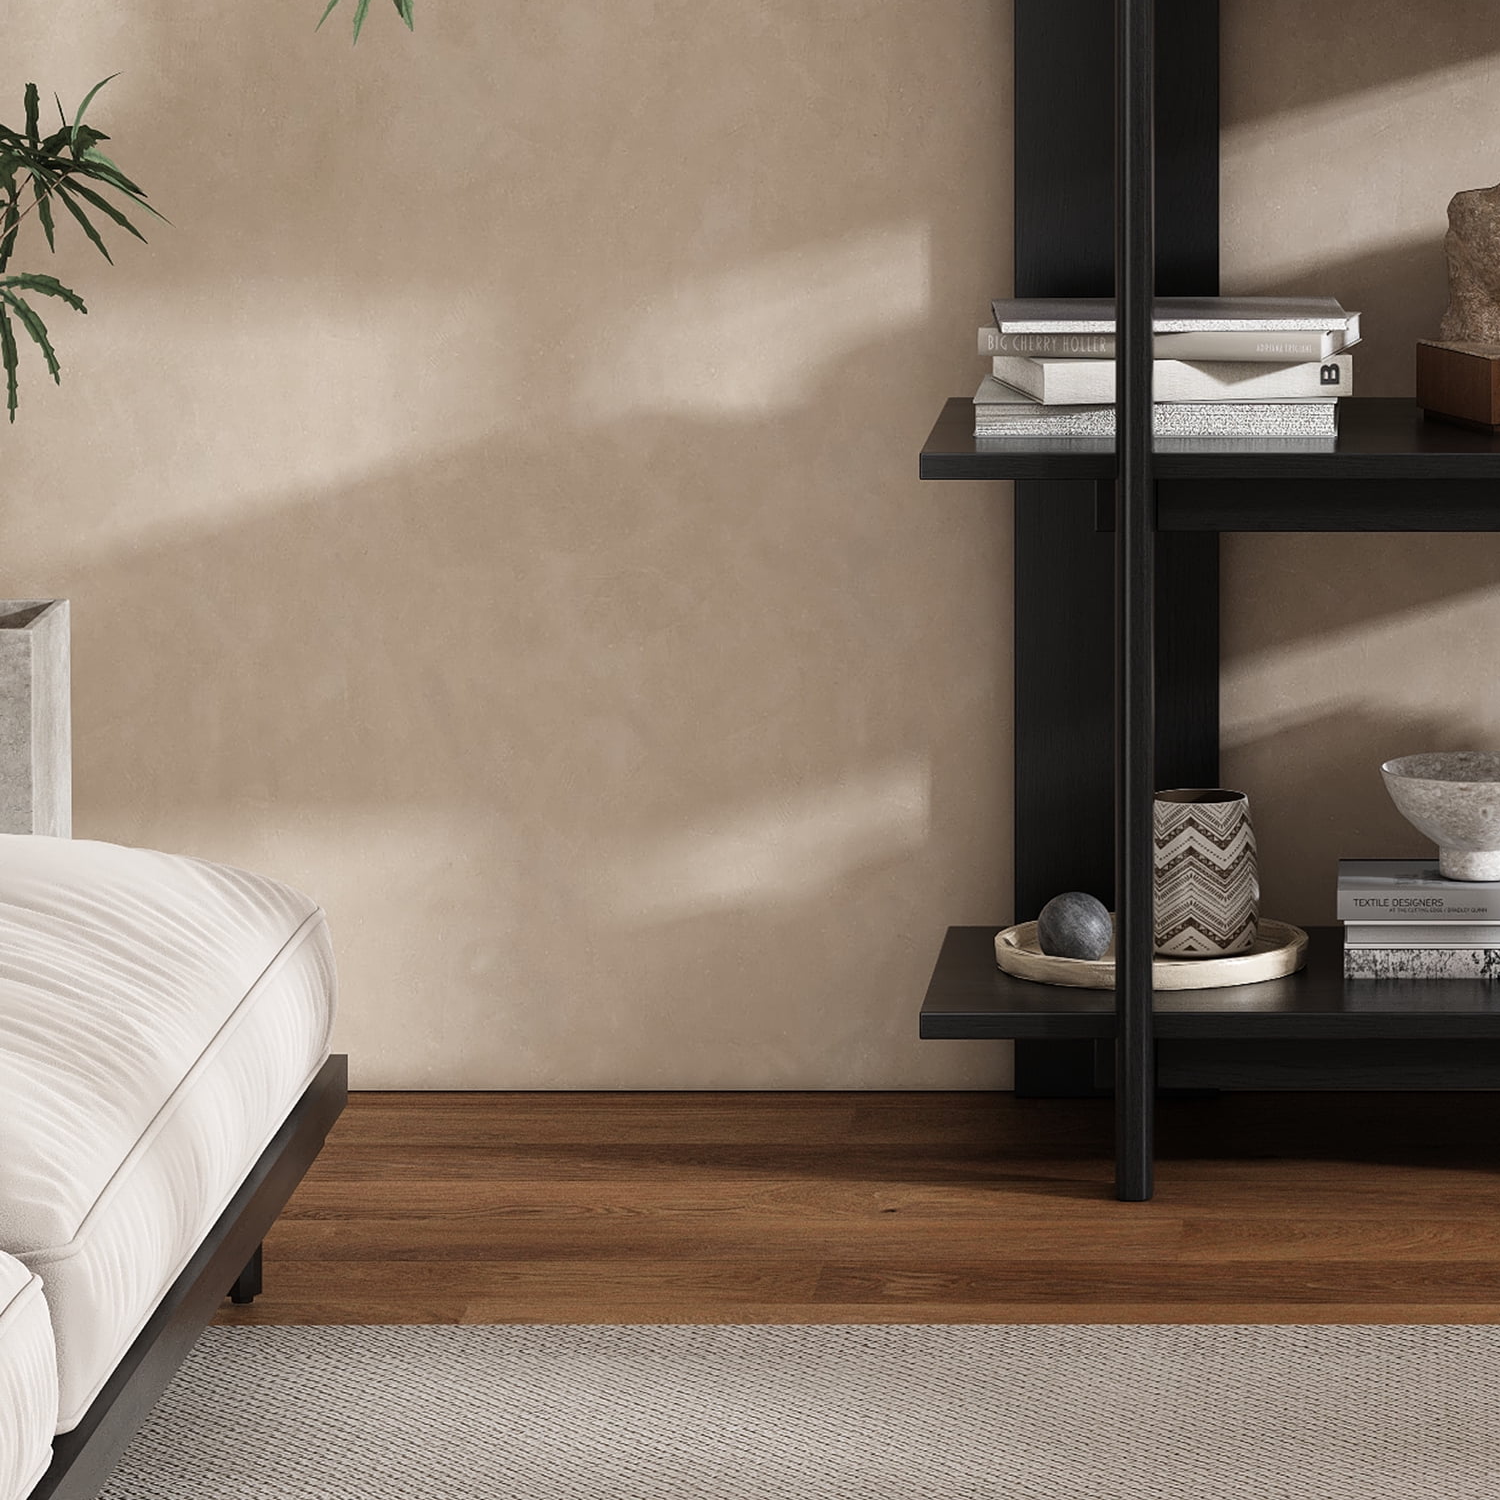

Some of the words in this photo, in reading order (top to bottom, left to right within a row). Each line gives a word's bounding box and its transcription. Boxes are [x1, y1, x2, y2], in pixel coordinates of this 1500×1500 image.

[986, 334, 1008, 352] BIG
[1012, 334, 1058, 352] CHERRY
[1062, 335, 1107, 353] HOLLER
[1320, 363, 1341, 385] B
[1353, 898, 1389, 907] TEXTILE
[1392, 898, 1444, 907] DESIGNERS
